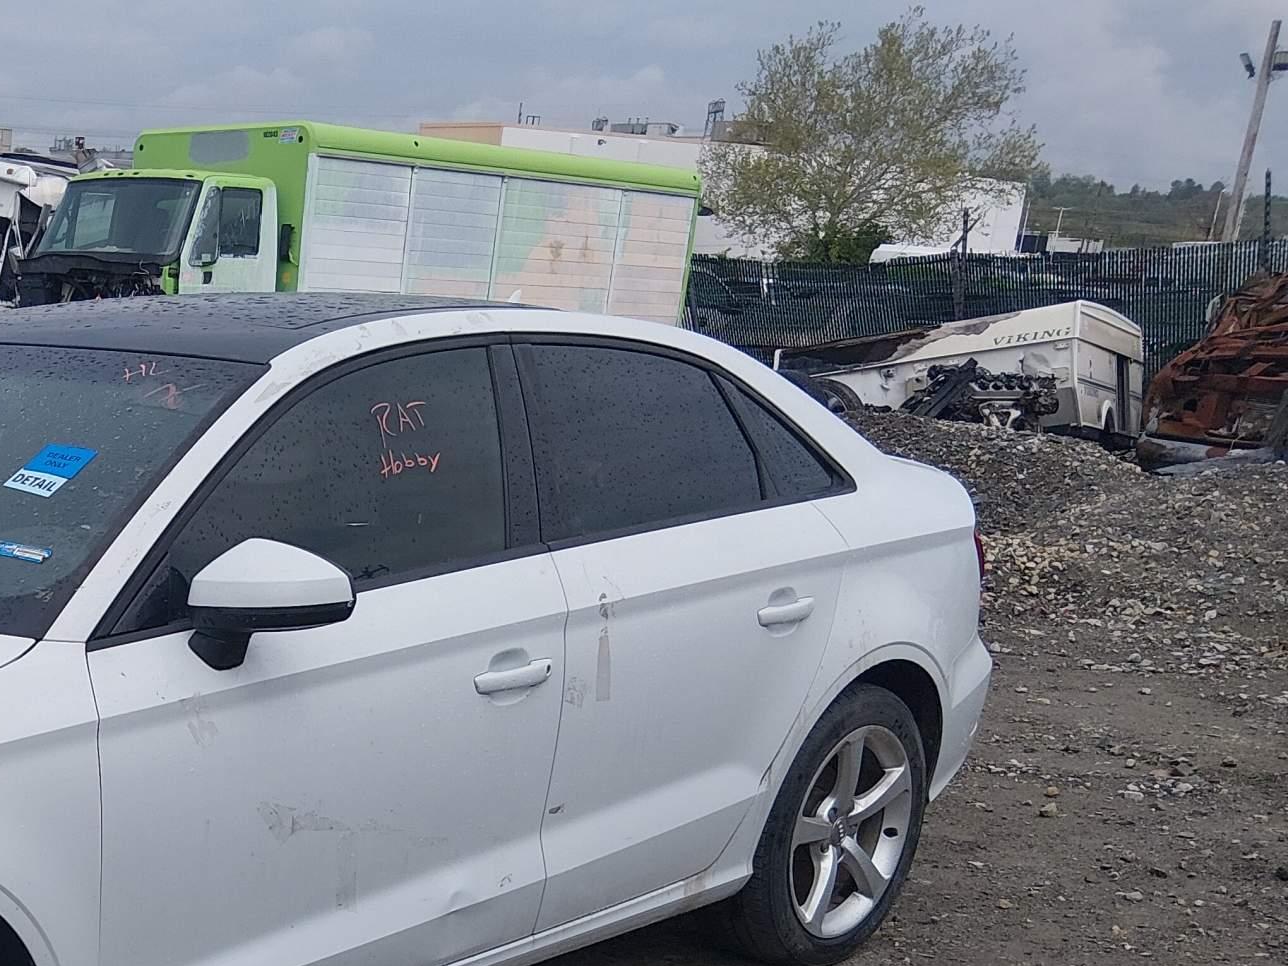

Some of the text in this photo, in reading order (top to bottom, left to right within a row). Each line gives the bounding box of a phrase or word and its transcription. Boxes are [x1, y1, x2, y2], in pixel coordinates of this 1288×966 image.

[993, 327, 1071, 345] VIKING
[370, 401, 426, 448] RAT
[45, 460, 68, 469] ONLY
[47, 452, 81, 462] DEALER
[380, 449, 440, 478] Hobby
[12, 473, 57, 491] DETAIL
